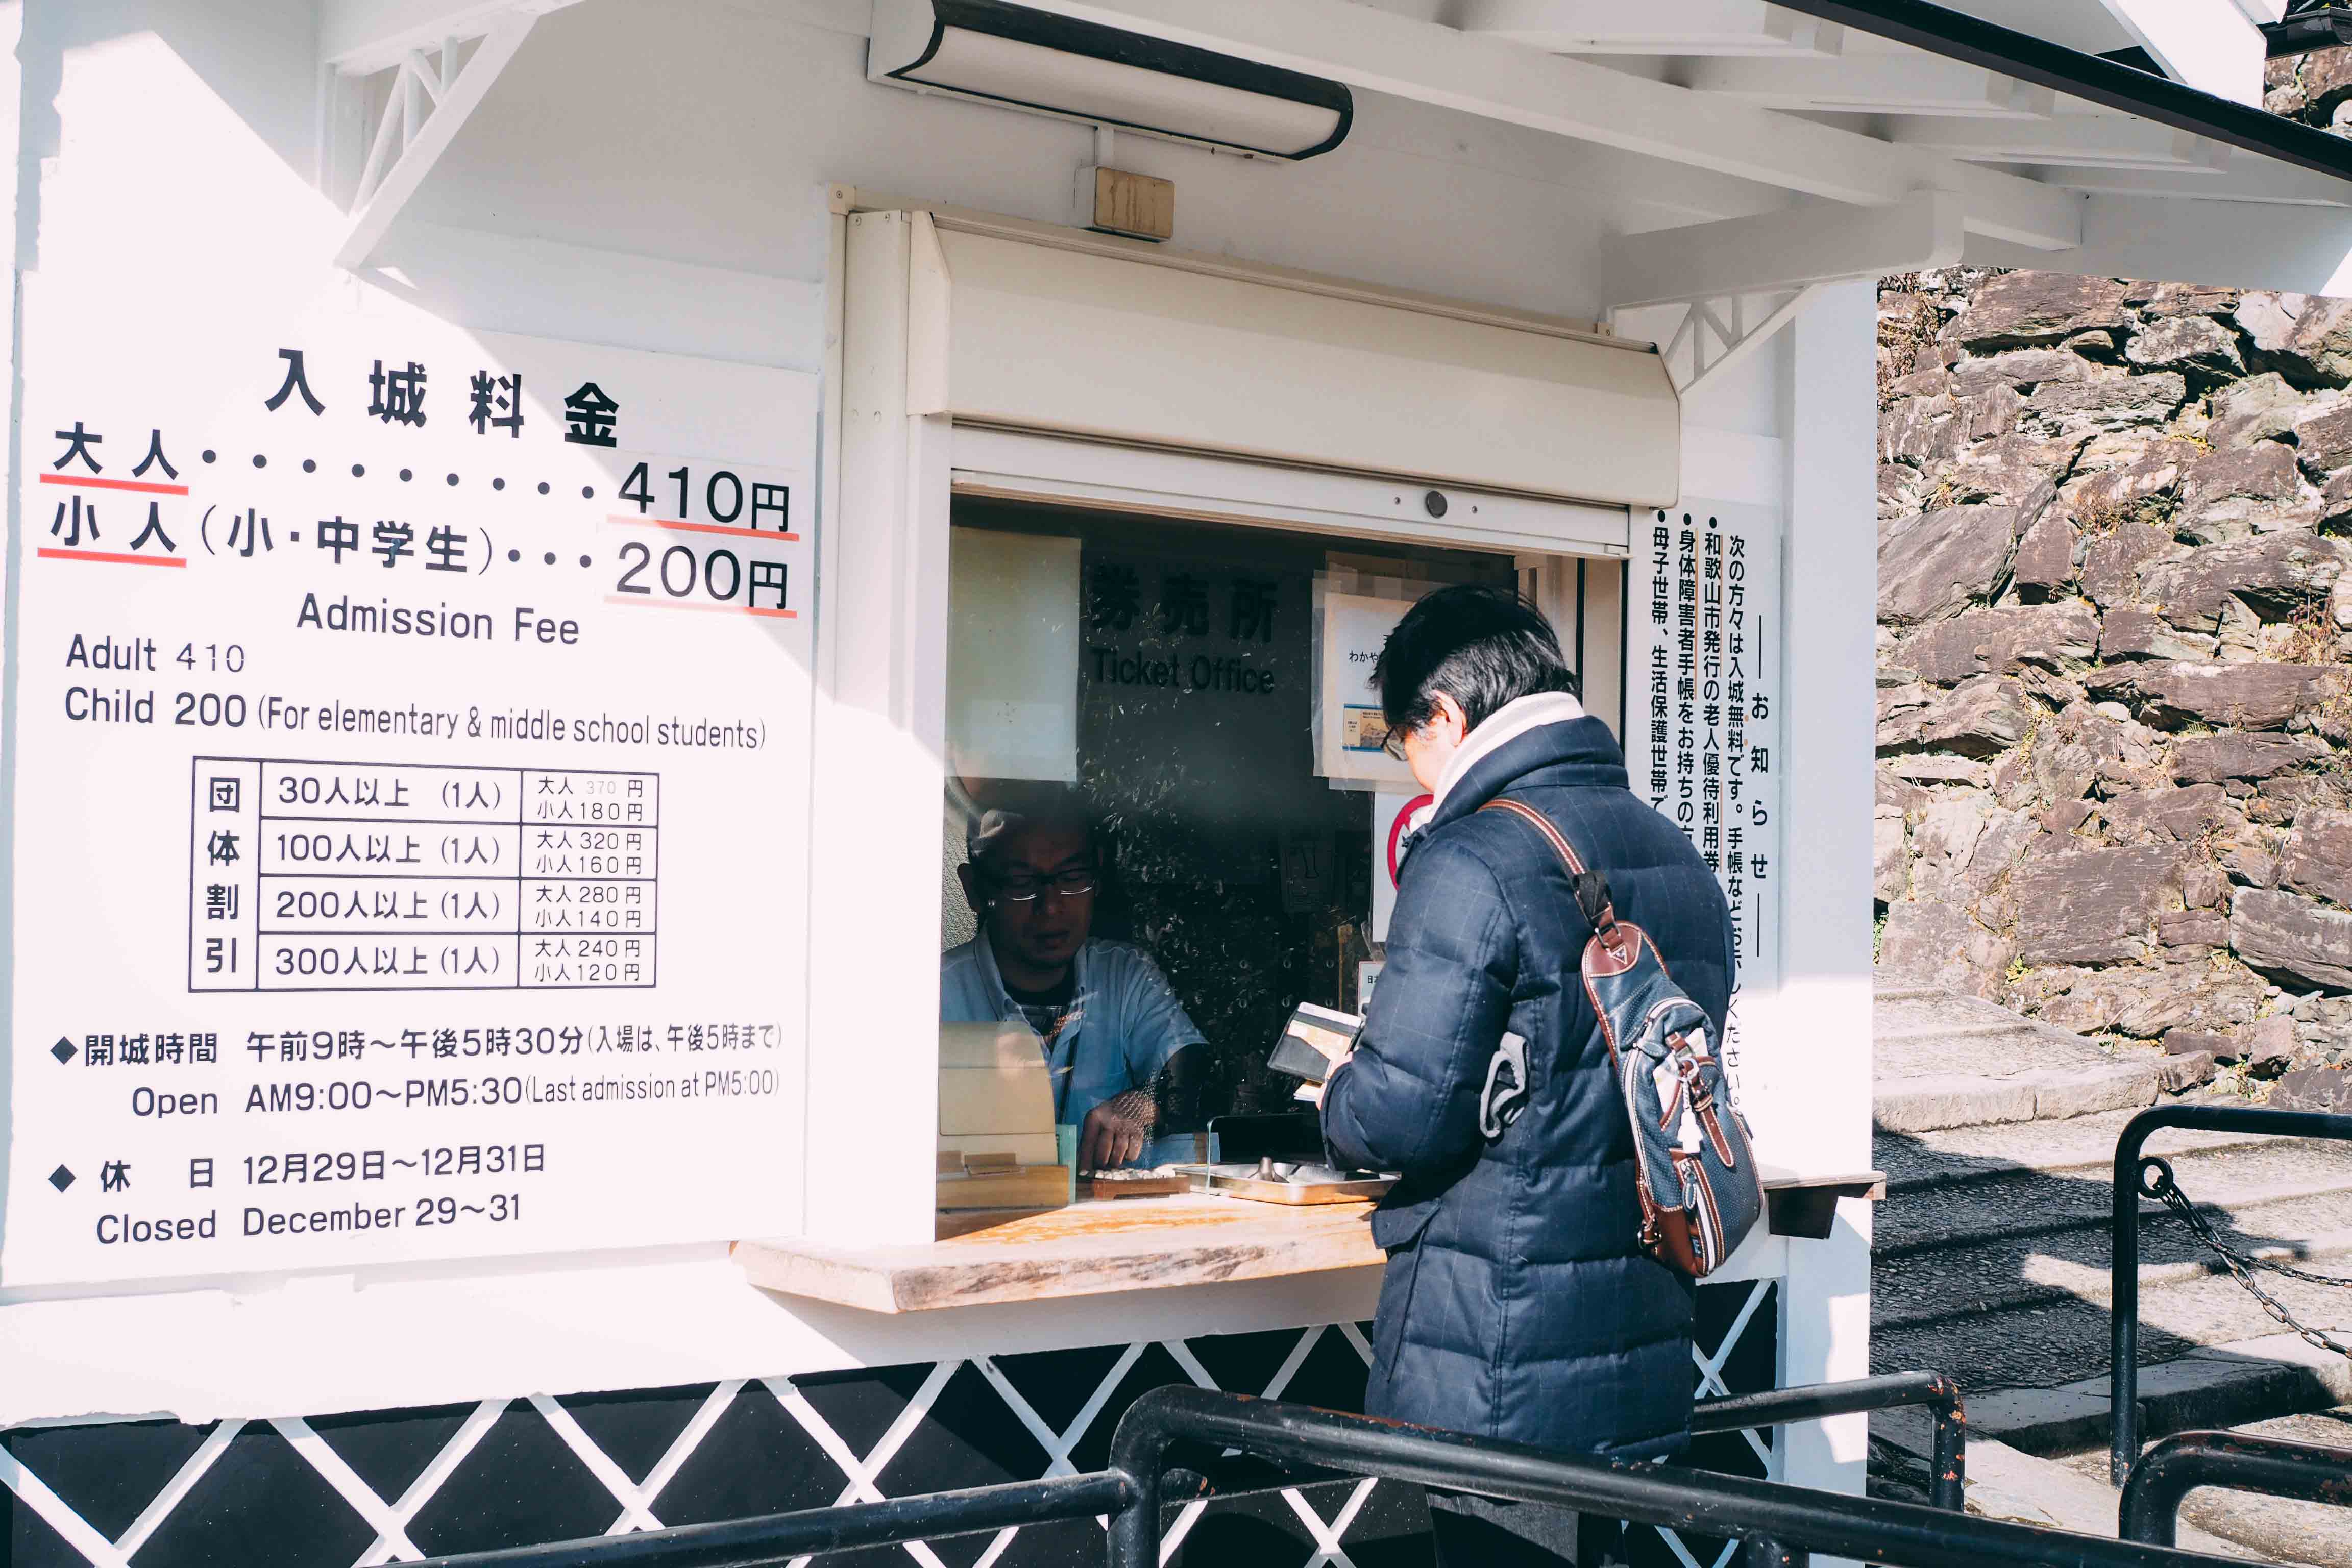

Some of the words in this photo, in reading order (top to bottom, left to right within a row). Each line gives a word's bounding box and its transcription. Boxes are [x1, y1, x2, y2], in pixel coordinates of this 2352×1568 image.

[264, 348, 619, 448] 入城料金
[53, 421, 179, 480] 大人
[297, 593, 492, 640] Admission
[515, 607, 579, 644] Fee
[65, 634, 156, 671] Adult
[176, 643, 244, 672] 410
[1089, 646, 1180, 687] Ticket
[1192, 654, 1275, 694] Office
[65, 687, 153, 723] Child
[175, 692, 246, 727] 200
[259, 696, 310, 730] (For
[318, 700, 458, 739] elementary
[468, 709, 481, 737] &
[491, 711, 565, 740] middle
[574, 714, 649, 744] school
[658, 718, 765, 748] students)
[279, 777, 409, 806] 30人以上
[1751, 692, 1769, 879] お知らせ
[278, 834, 421, 863] 100人以上
[86, 1033, 217, 1066] 開城時間
[133, 1087, 217, 1119] Open
[583, 1074, 674, 1101] admission
[682, 1072, 698, 1097] at
[706, 1070, 779, 1096] PM5:00)
[97, 1210, 215, 1244] Closed
[244, 1202, 406, 1236] December
